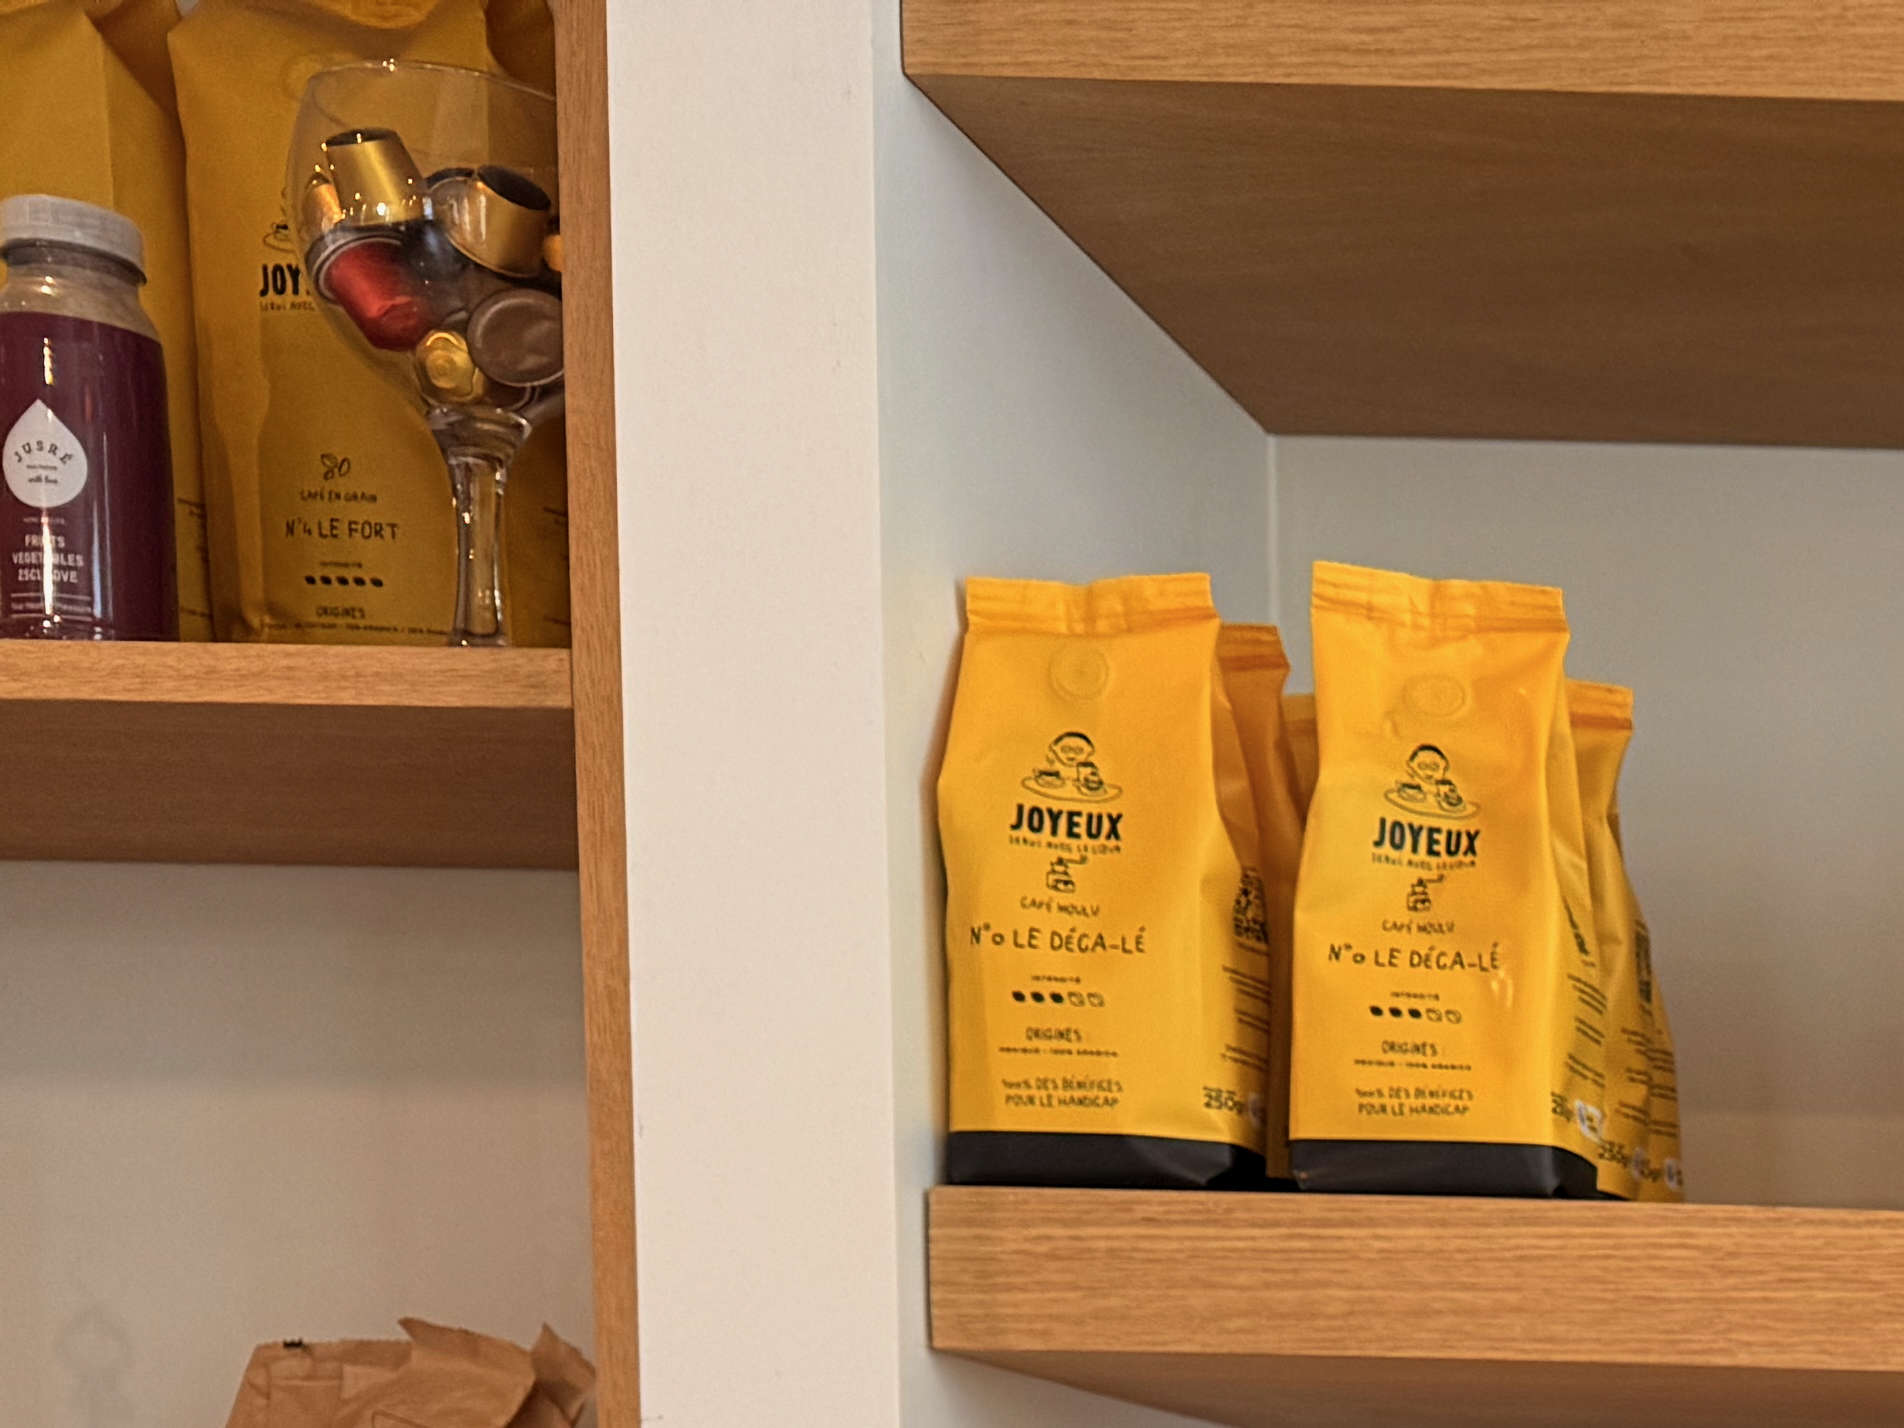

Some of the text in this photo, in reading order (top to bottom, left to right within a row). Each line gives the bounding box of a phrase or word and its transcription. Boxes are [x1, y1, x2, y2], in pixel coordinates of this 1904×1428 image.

[317, 517, 398, 541] LE FORT
[1010, 804, 1123, 844] JOYEUX
[1013, 926, 1146, 954] LE DÉCA-LÉ
